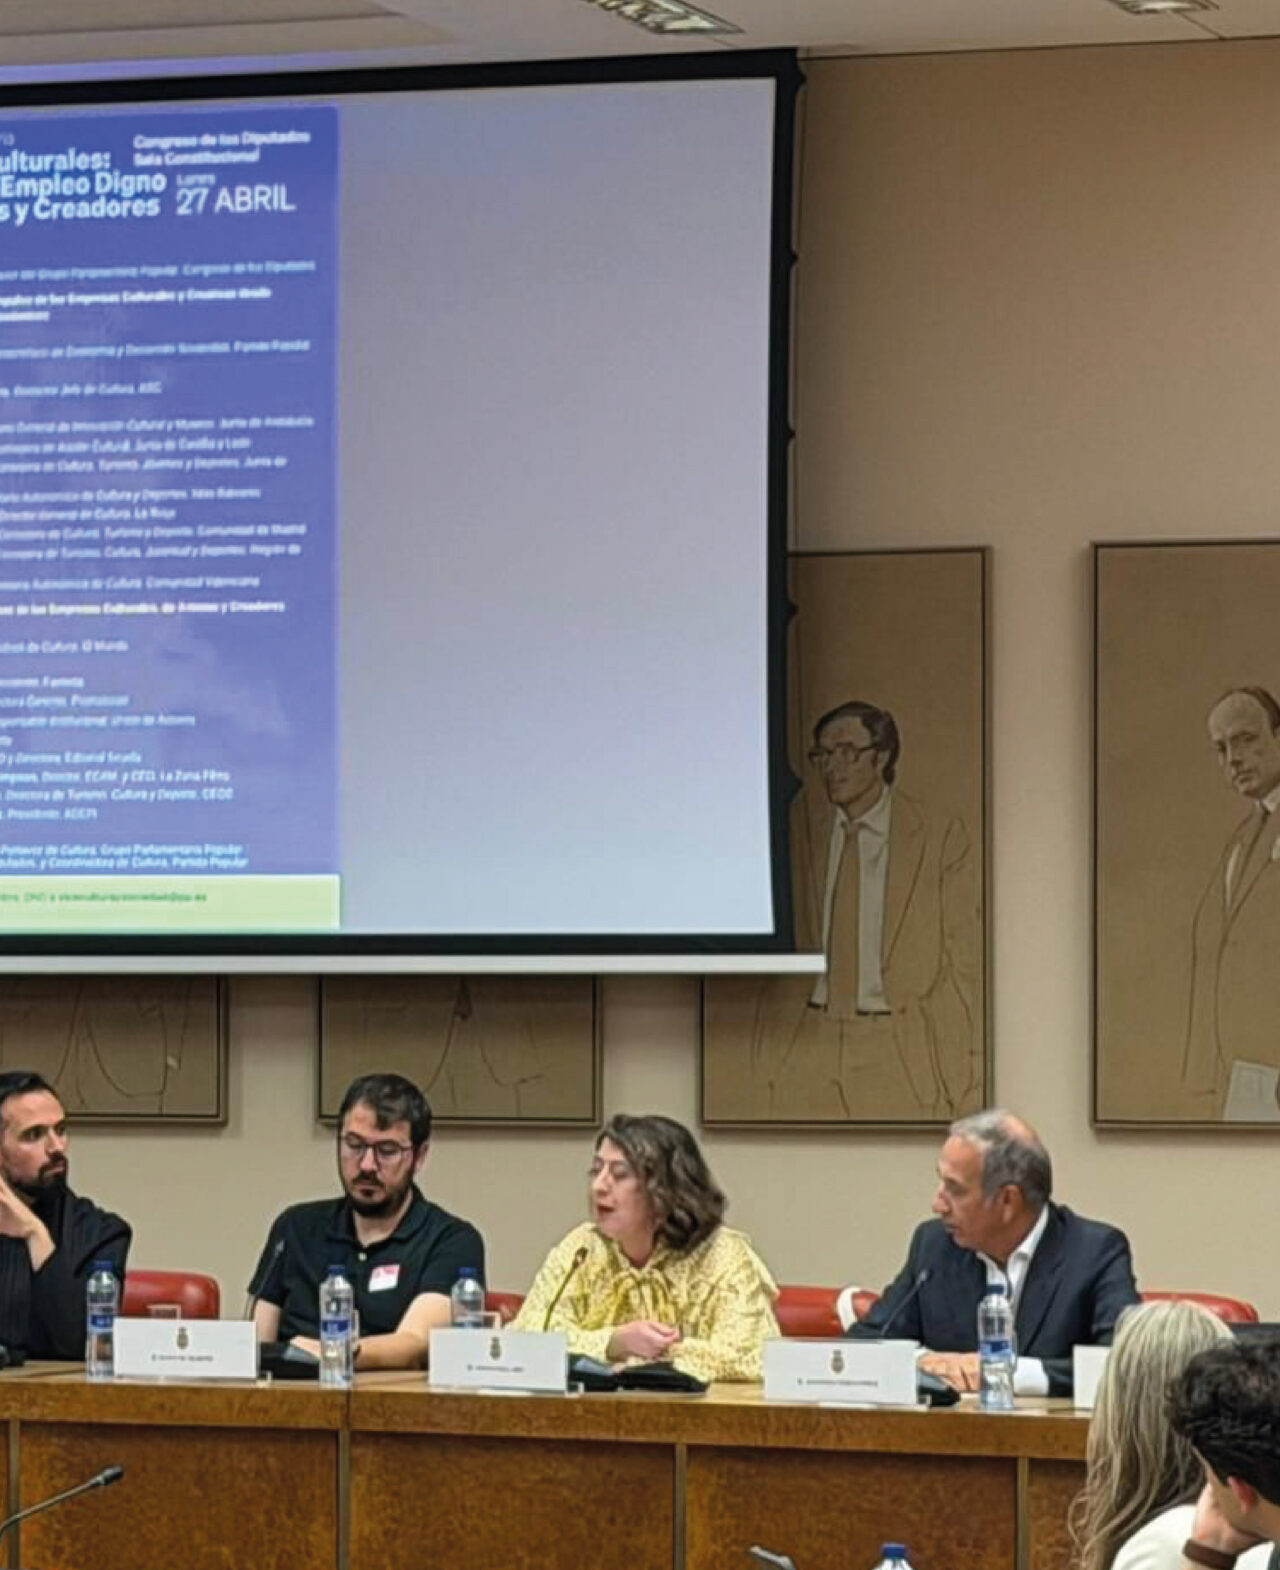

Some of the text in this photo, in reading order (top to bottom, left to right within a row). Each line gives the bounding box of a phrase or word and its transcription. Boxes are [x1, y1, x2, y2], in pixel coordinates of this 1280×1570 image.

[133, 130, 311, 149] Congreso de los Diputados
[134, 148, 260, 166] Sala Constitucional
[0, 172, 90, 200] Empleo
[95, 169, 167, 197] Digno
[176, 173, 215, 187] Lunes
[15, 203, 29, 226] y
[34, 196, 160, 220] Creadores
[176, 183, 296, 215] 27 ABRIL
